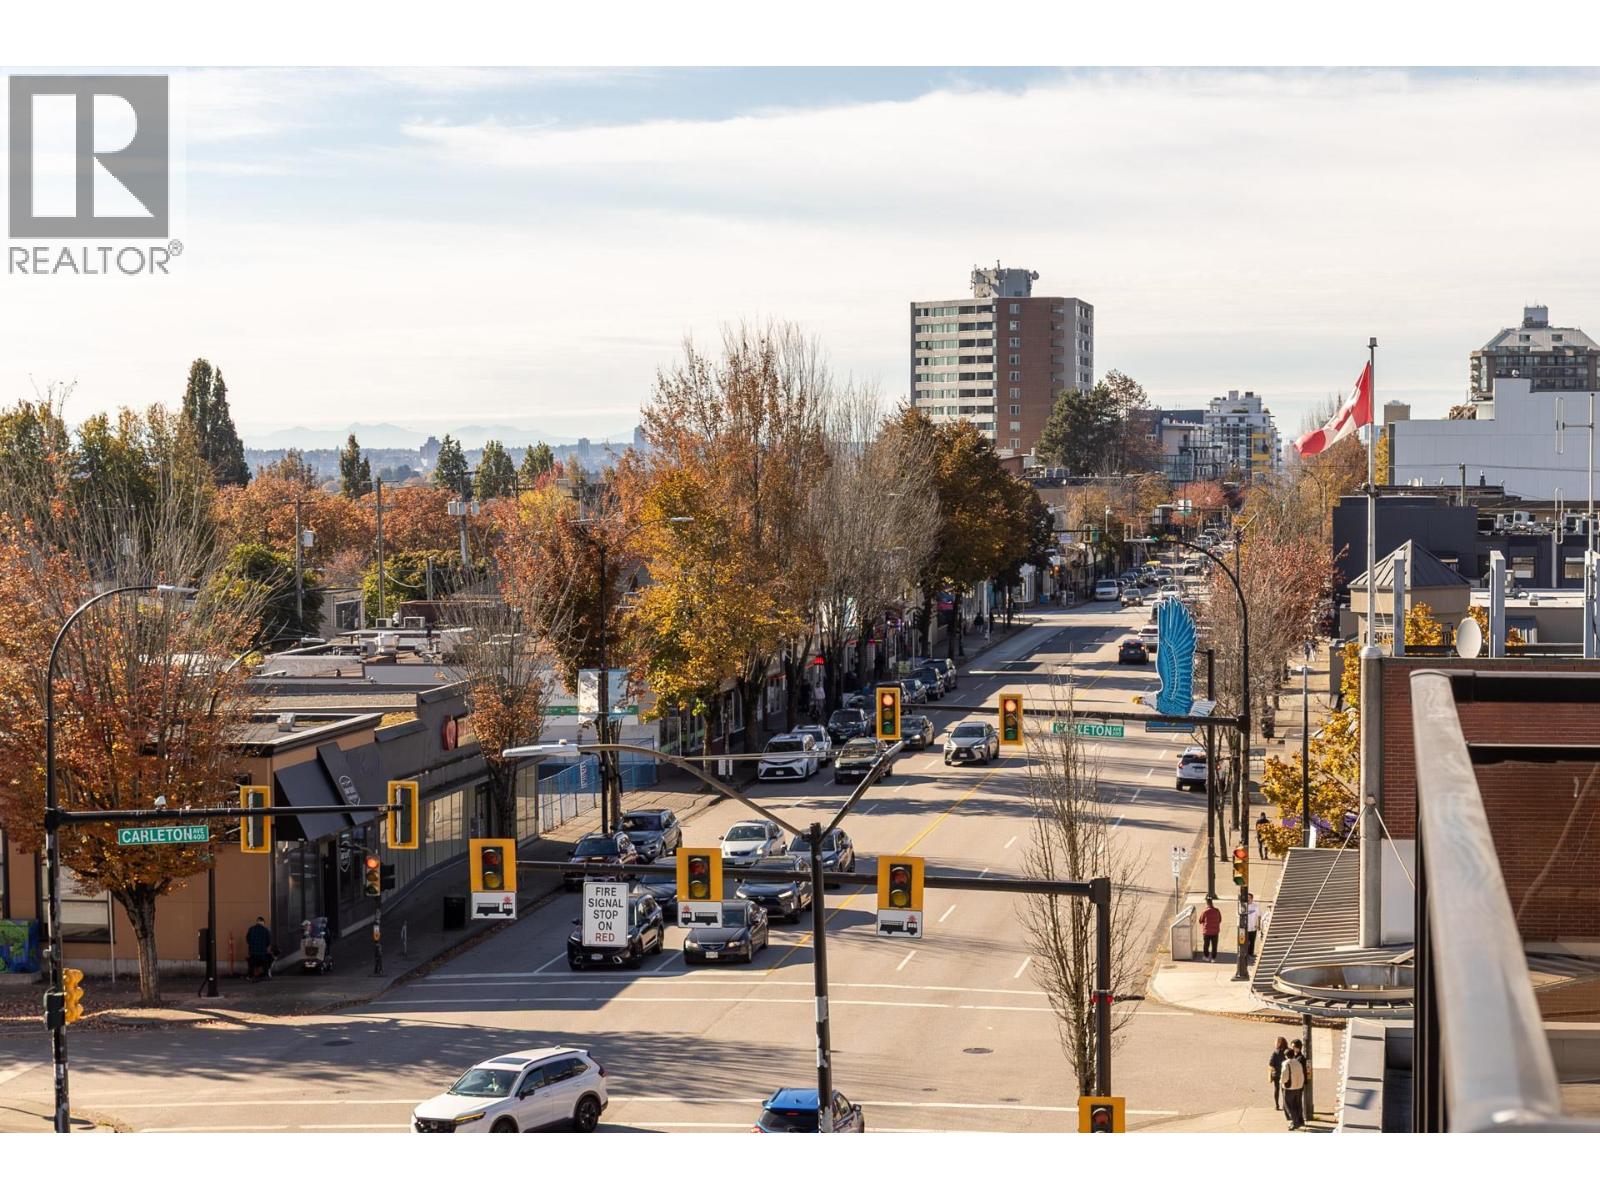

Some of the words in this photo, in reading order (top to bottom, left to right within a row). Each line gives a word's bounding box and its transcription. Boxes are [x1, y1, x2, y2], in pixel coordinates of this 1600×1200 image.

[121, 828, 193, 843] CARLETON
[595, 886, 617, 897] FIRE
[588, 897, 624, 909] SIGNAL
[593, 909, 619, 920] STOP
[598, 920, 613, 931] ON
[595, 932, 616, 942] RED
